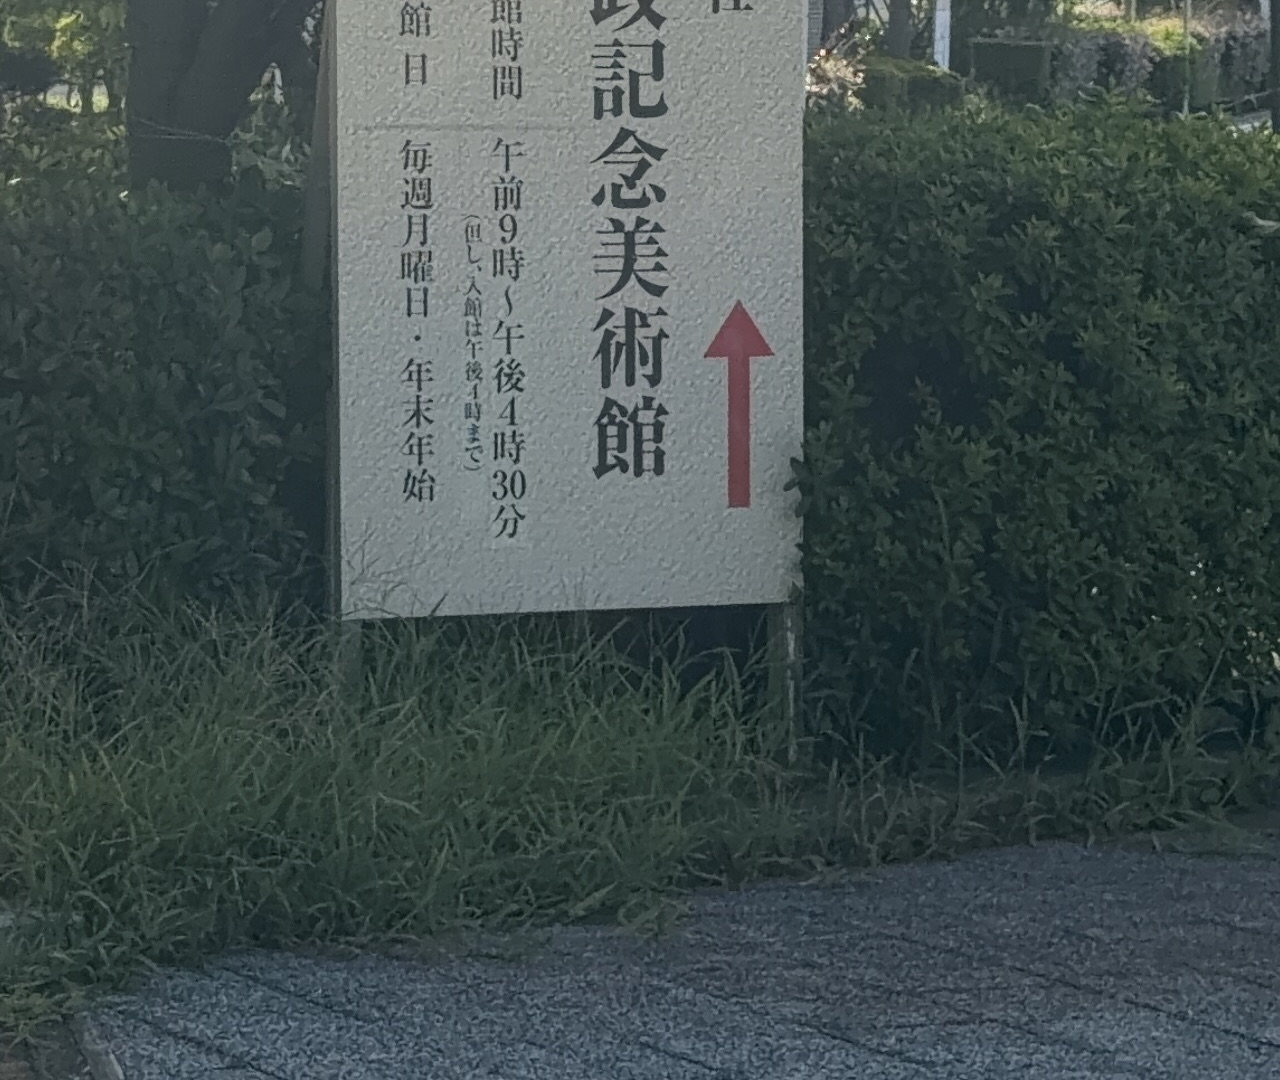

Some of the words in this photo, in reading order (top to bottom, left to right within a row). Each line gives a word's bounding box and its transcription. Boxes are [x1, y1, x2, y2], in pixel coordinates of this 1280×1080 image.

[400, 139, 435, 503] 毎週月曜日・年末年始
